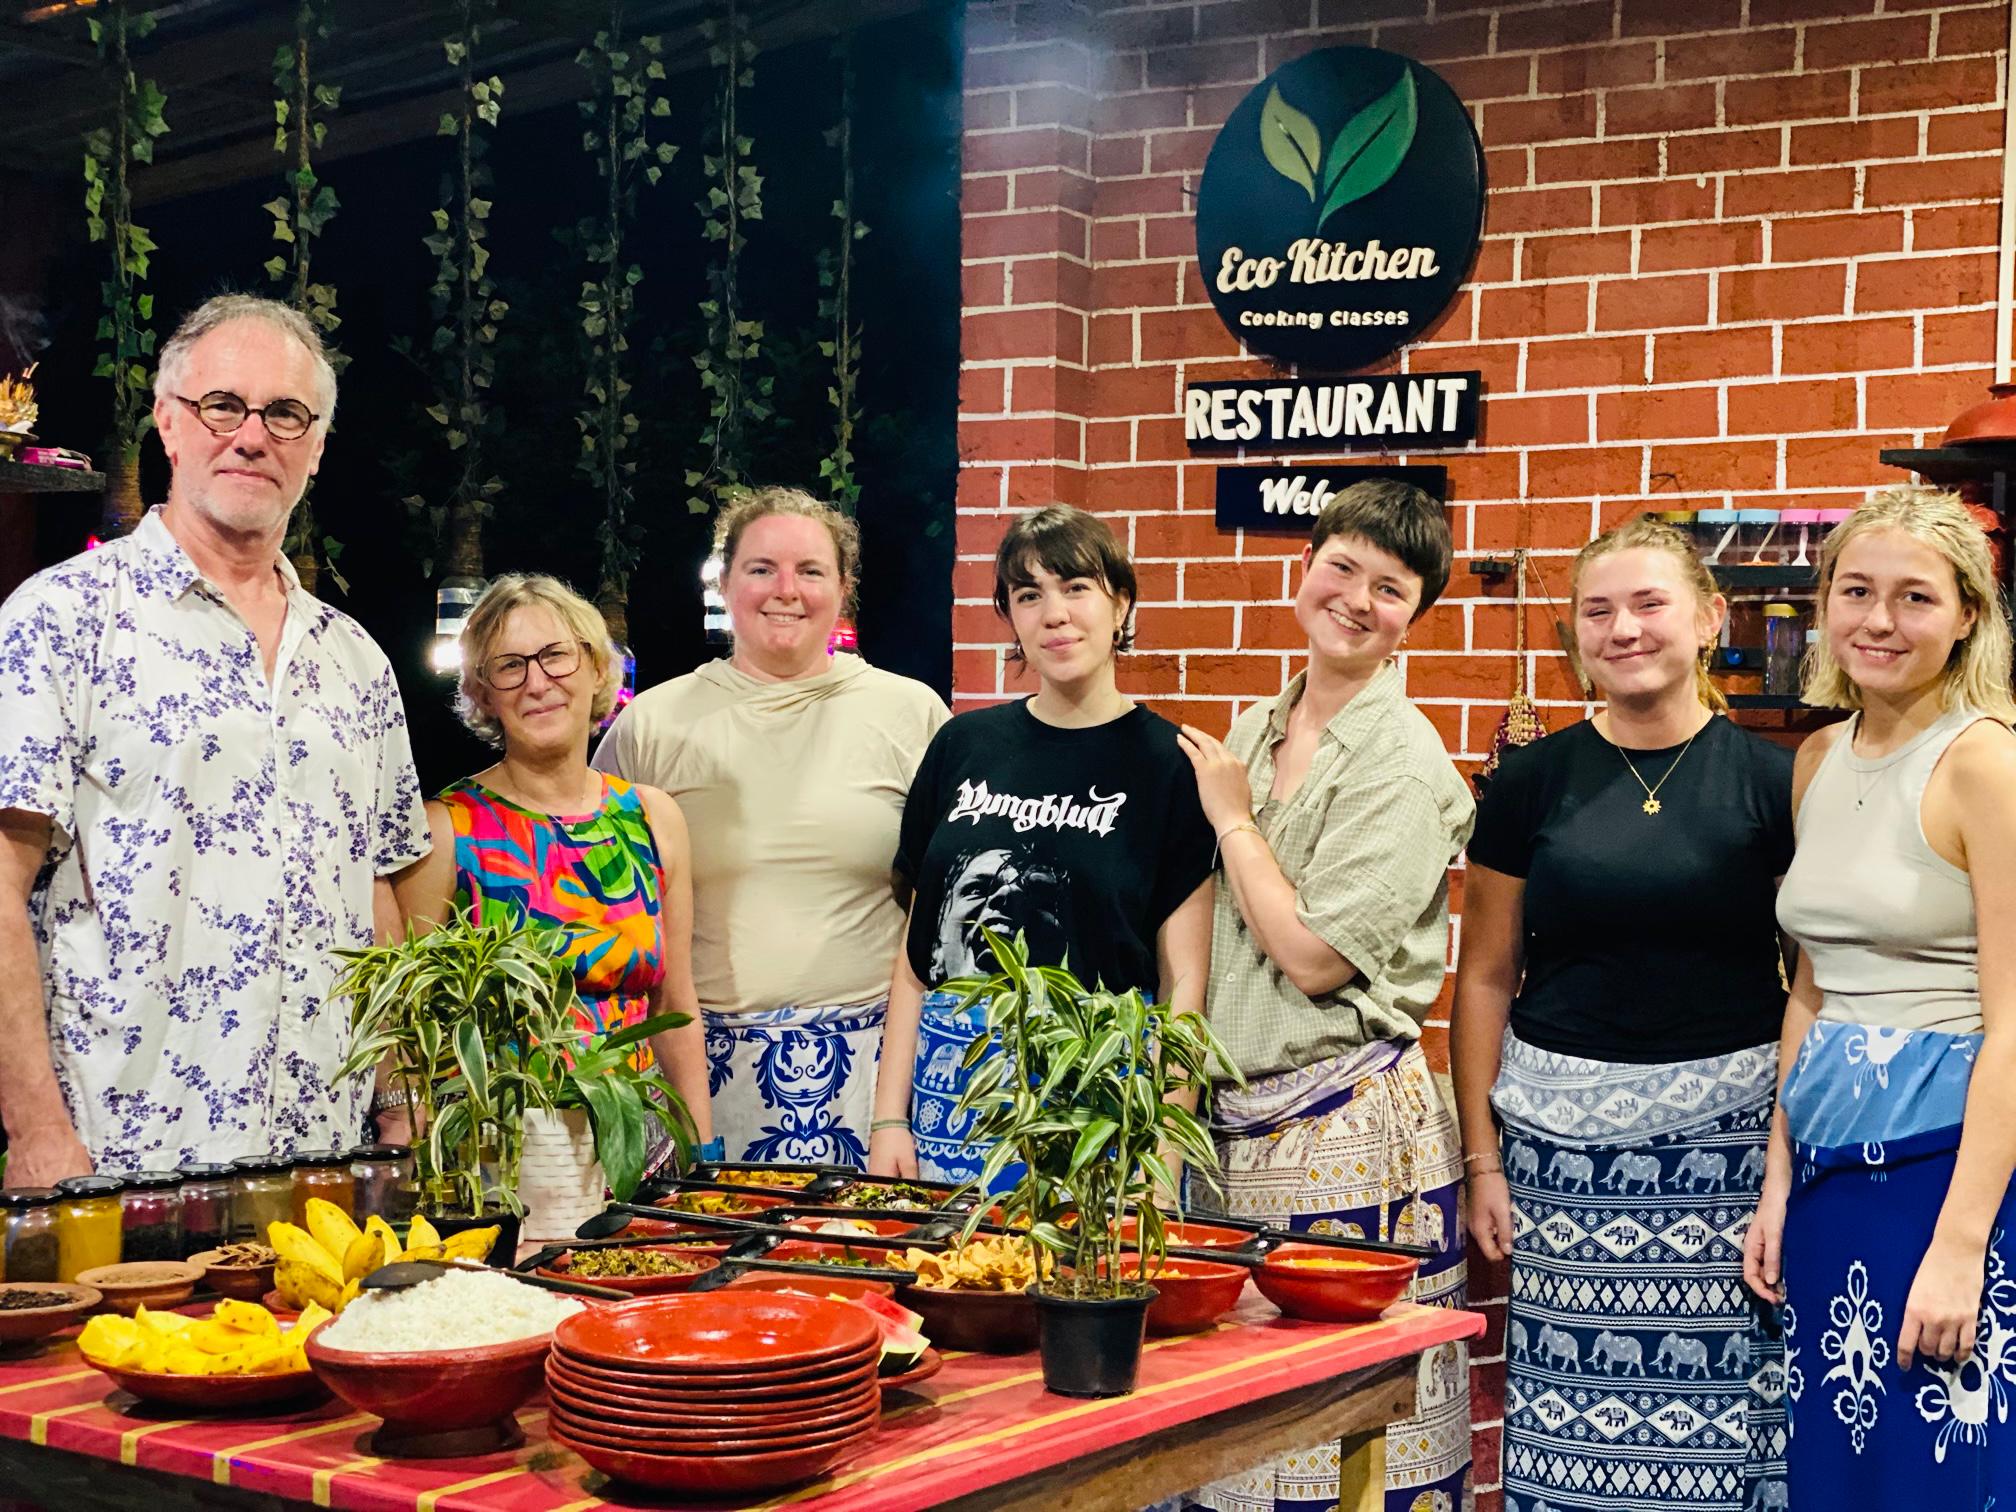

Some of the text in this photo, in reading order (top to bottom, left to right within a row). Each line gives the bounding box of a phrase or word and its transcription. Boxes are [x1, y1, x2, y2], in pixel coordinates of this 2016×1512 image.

[1216, 238, 1440, 293] Eco Kitchen
[1239, 310, 1409, 330] Cooking Classes
[1185, 378, 1468, 441] RESTAURANT
[1259, 475, 1337, 516] Welc
[948, 778, 1127, 838] Yungblud
